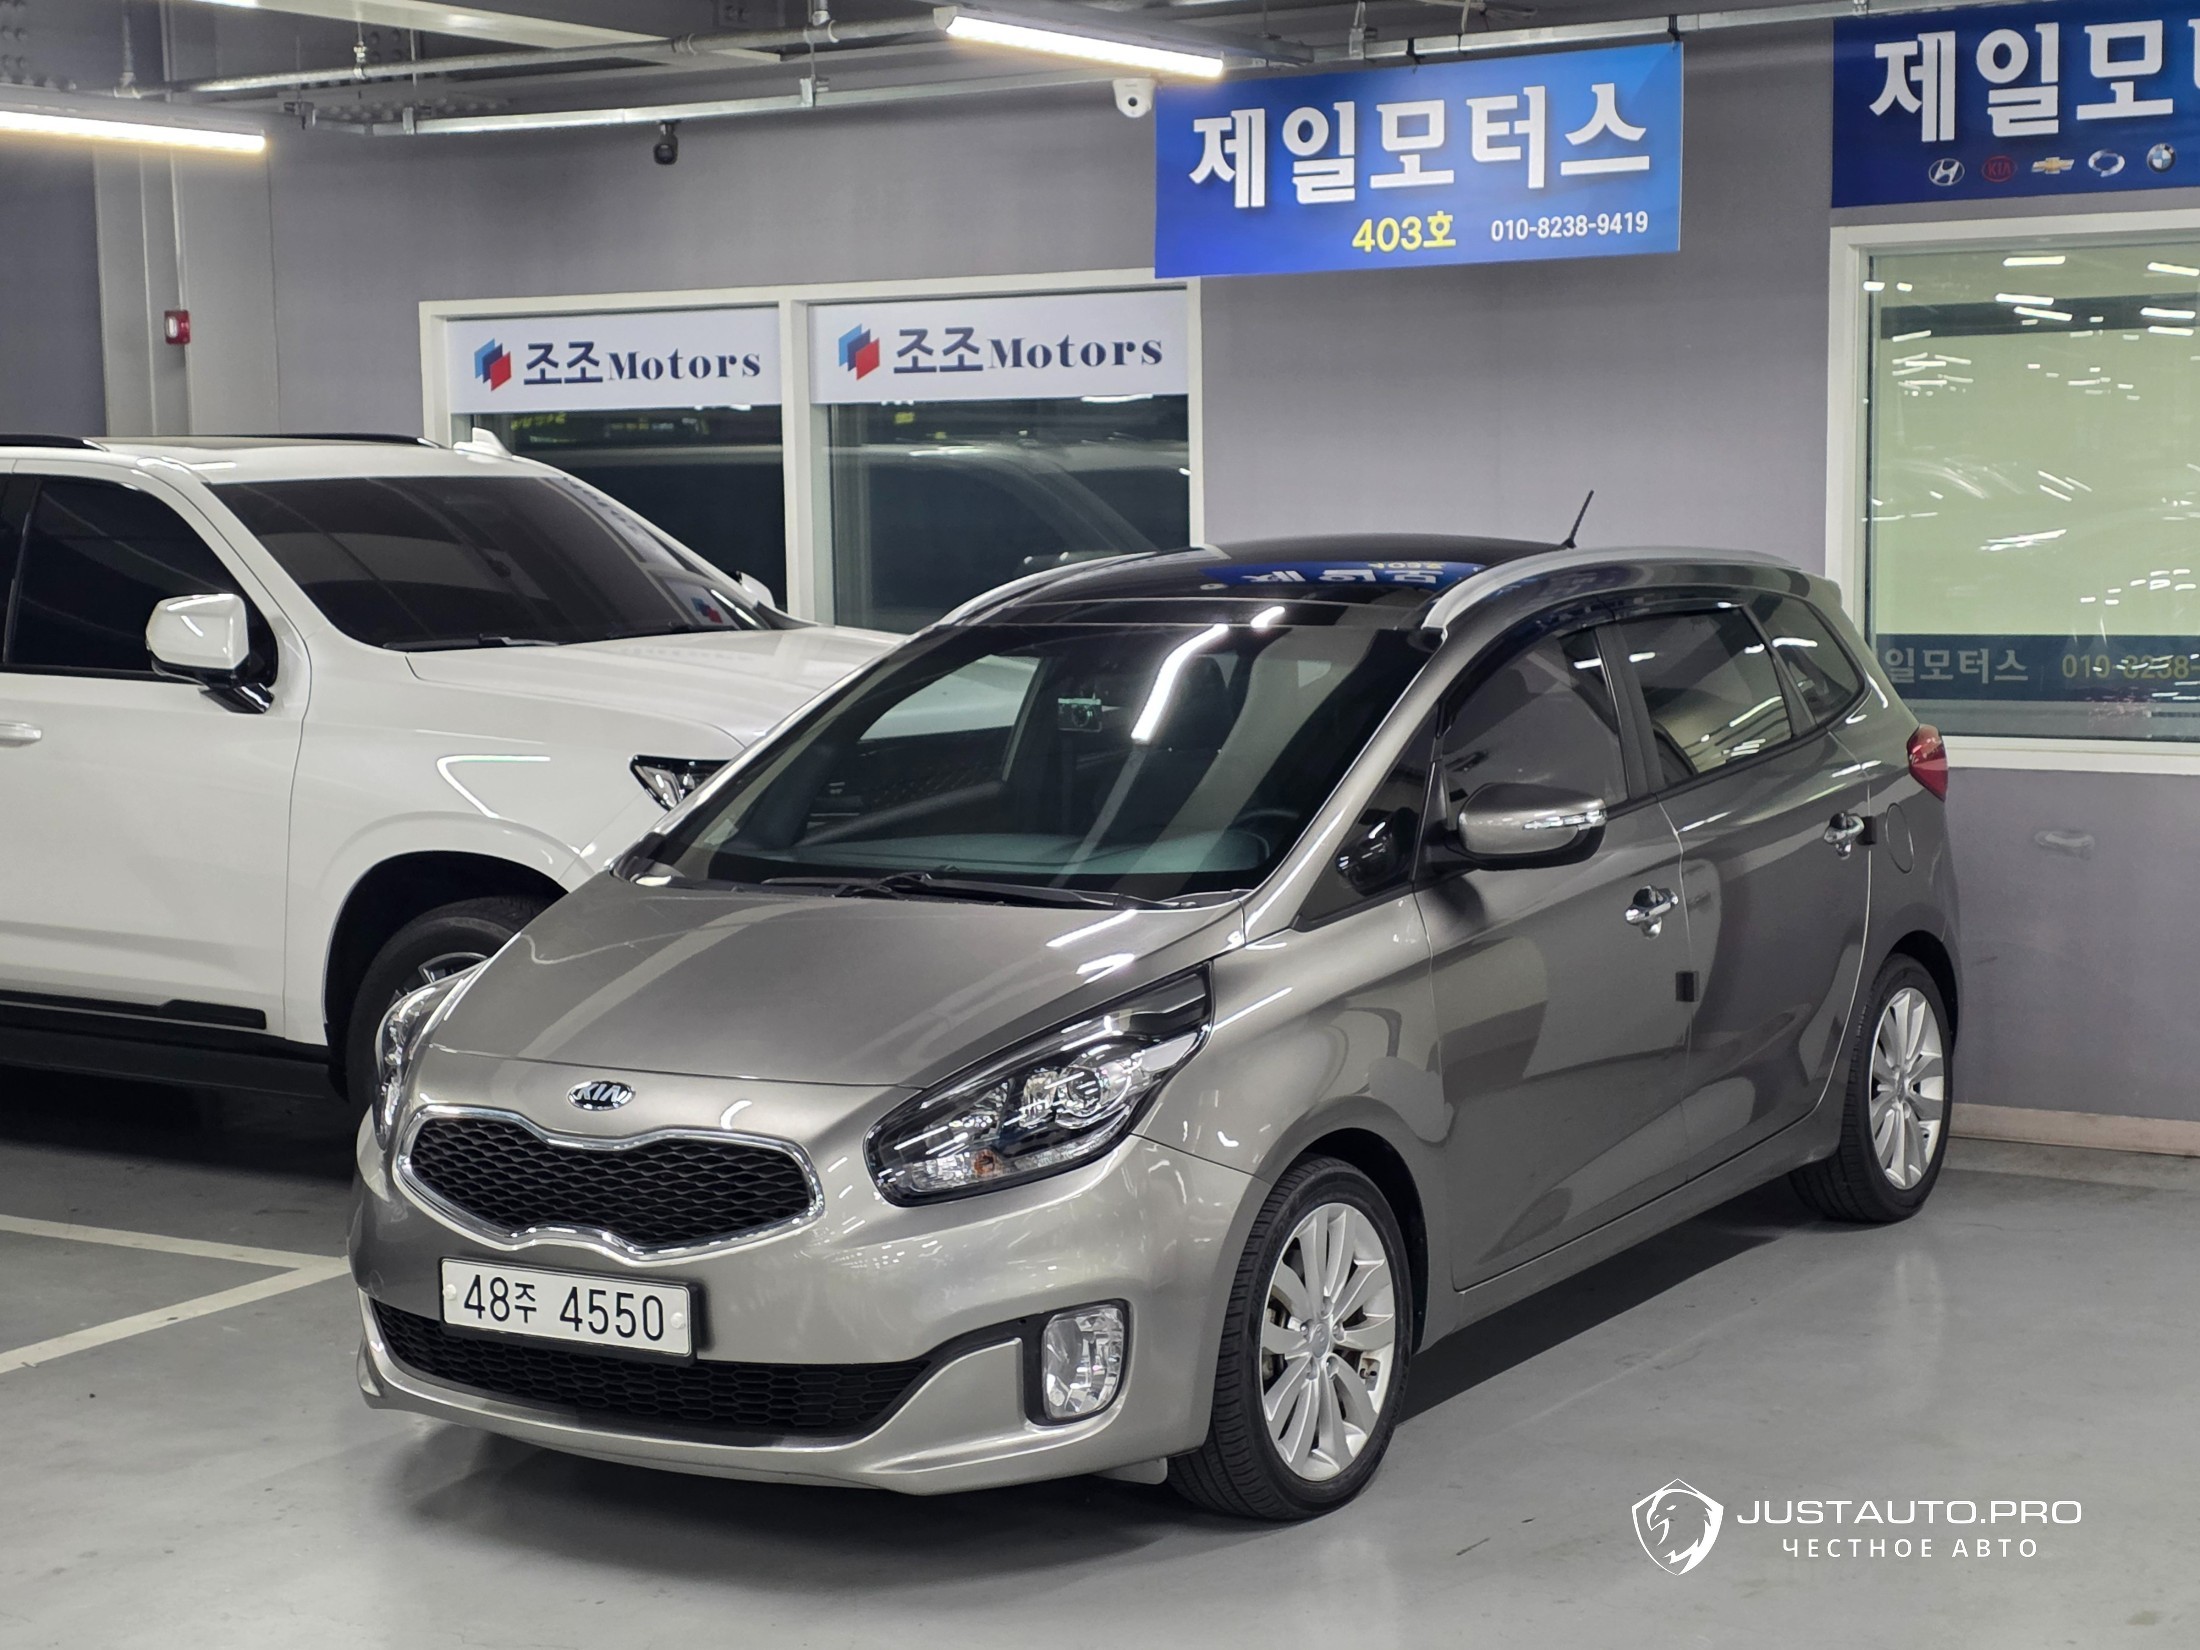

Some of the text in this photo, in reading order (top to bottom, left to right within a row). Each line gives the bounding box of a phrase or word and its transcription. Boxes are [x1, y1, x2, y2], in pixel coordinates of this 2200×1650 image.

[1869, 19, 2200, 142] 제일모
[1189, 83, 1650, 208] 제일모터스
[1352, 211, 1649, 253] 403호 010-8238-9419
[1876, 648, 2029, 684] 일모터스
[574, 1083, 628, 1103] KIA
[464, 1274, 664, 1342] 48주 4550
